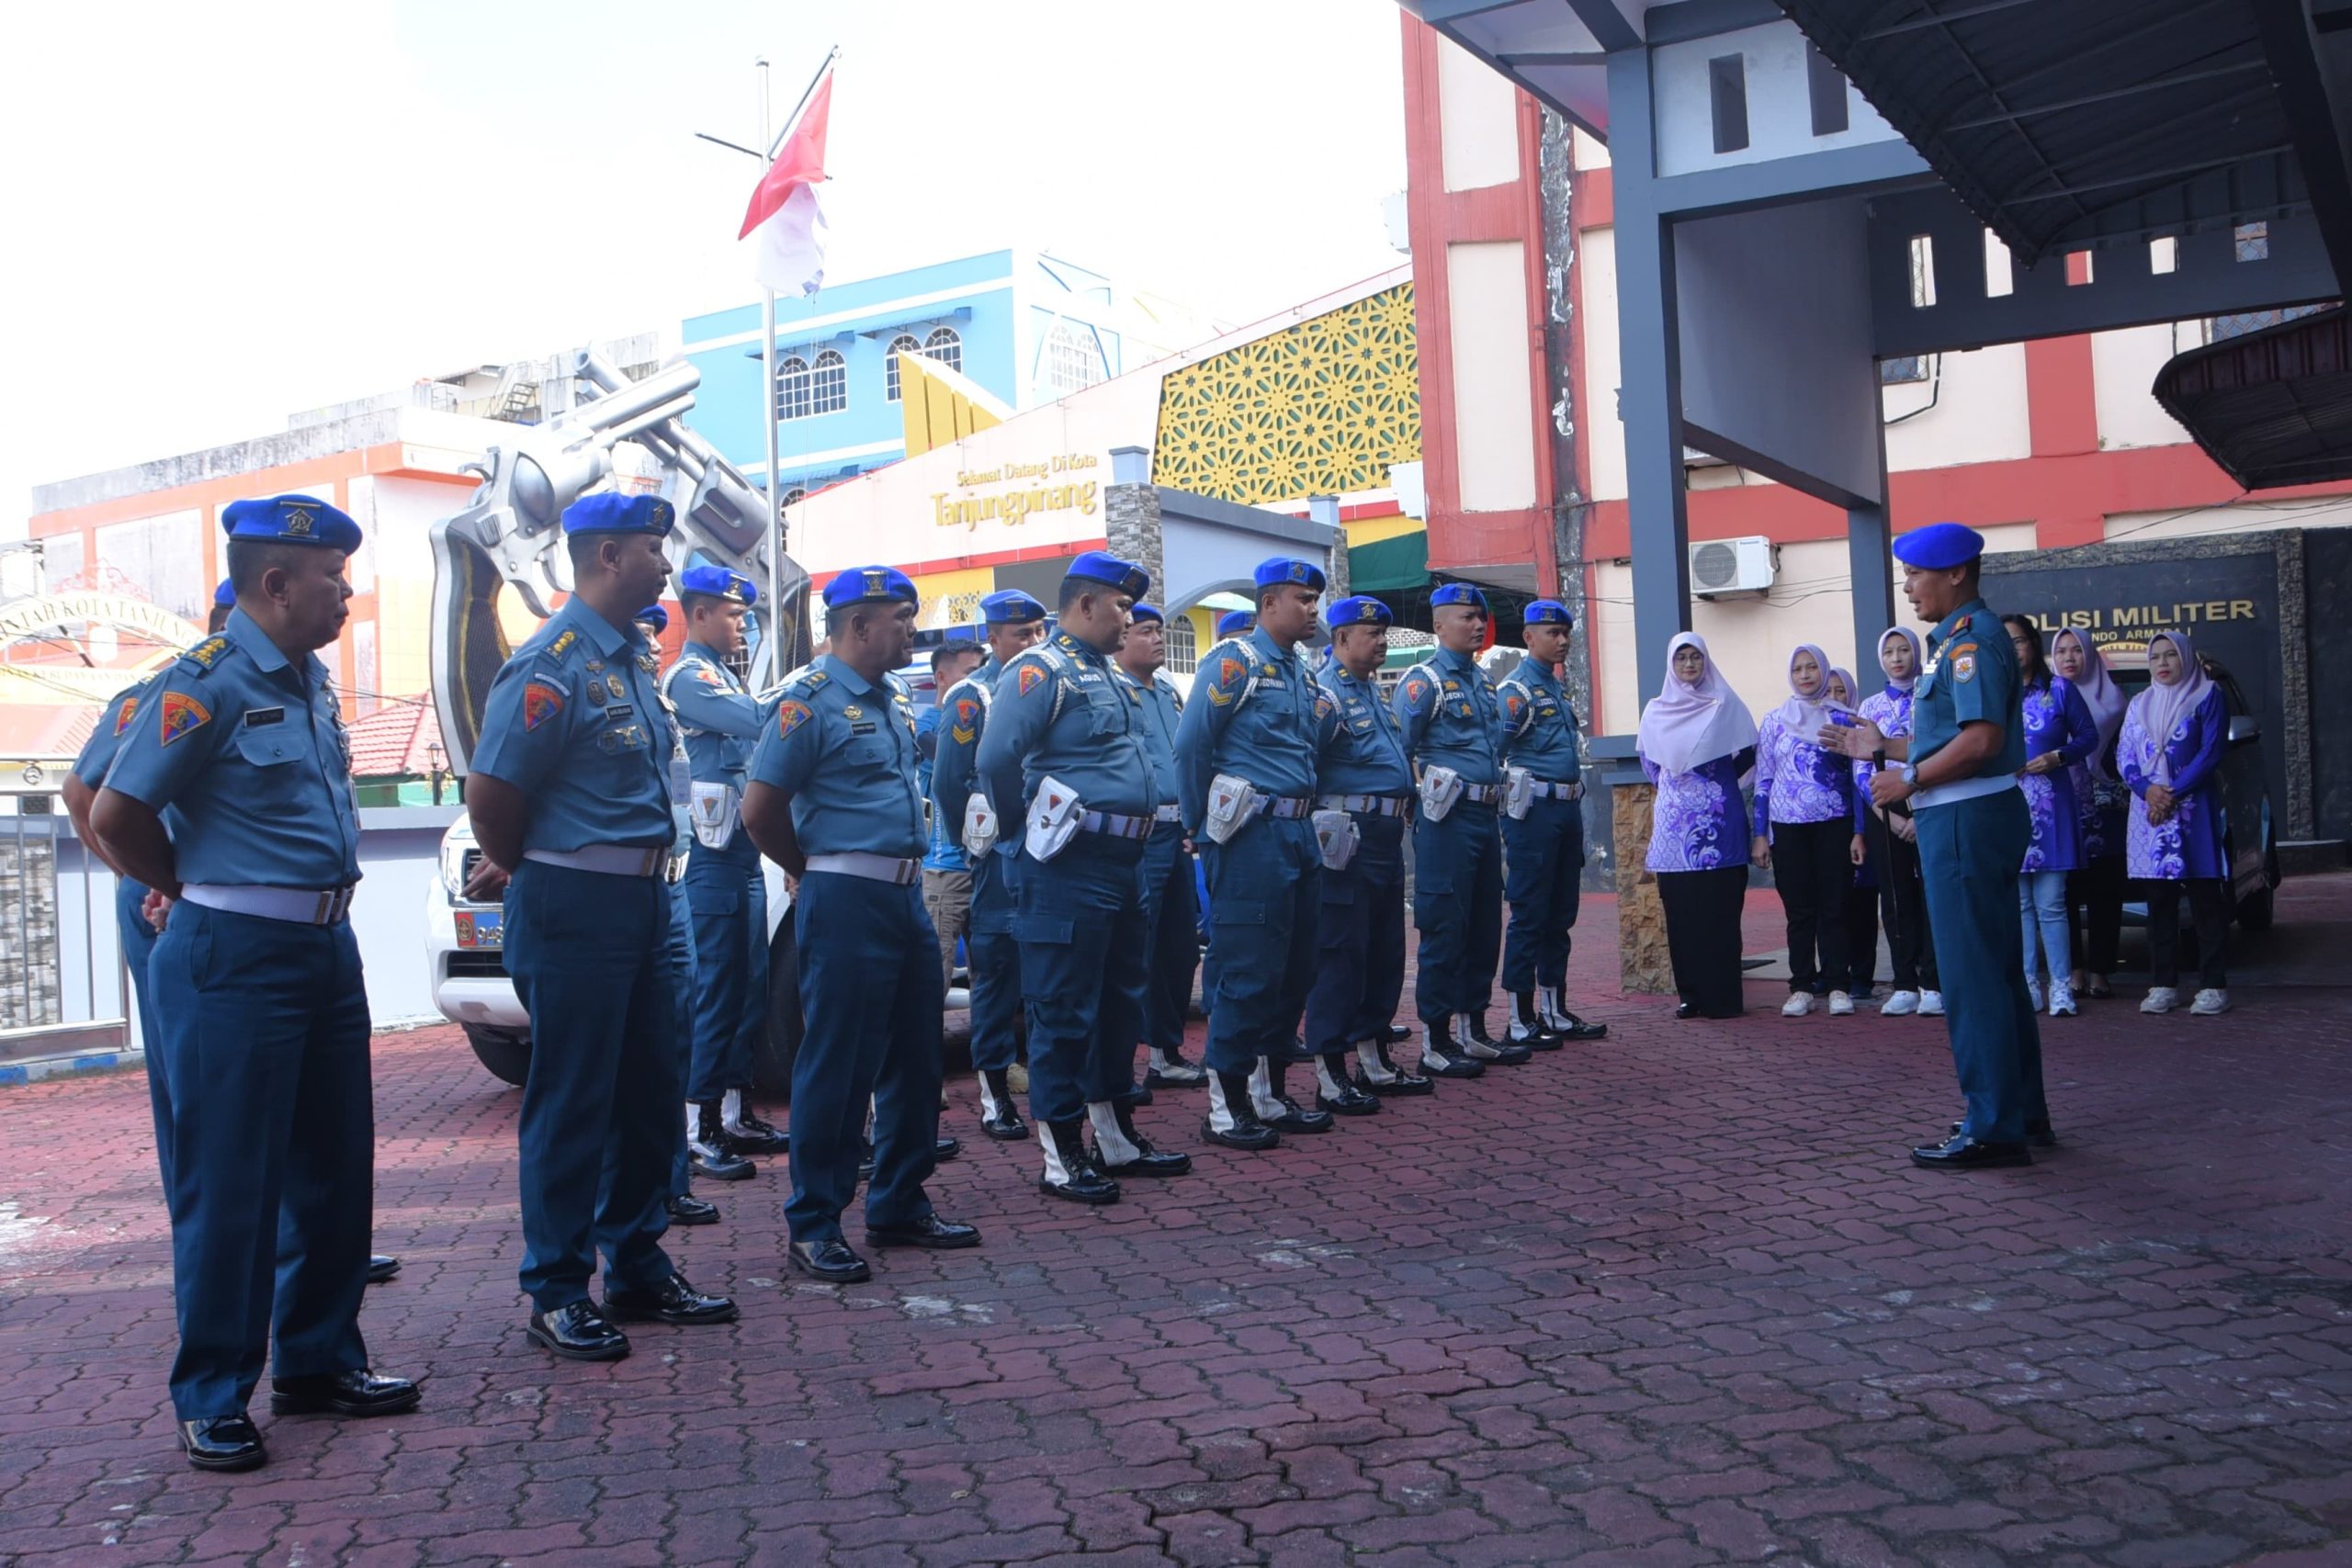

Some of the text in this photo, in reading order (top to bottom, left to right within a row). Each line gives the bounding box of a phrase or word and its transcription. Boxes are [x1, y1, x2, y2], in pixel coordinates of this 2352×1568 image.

[957, 453, 1097, 486] Selamat Datang Di Kota
[931, 480, 1097, 532] Tanjungpinang
[2112, 599, 2256, 627] MILITER
